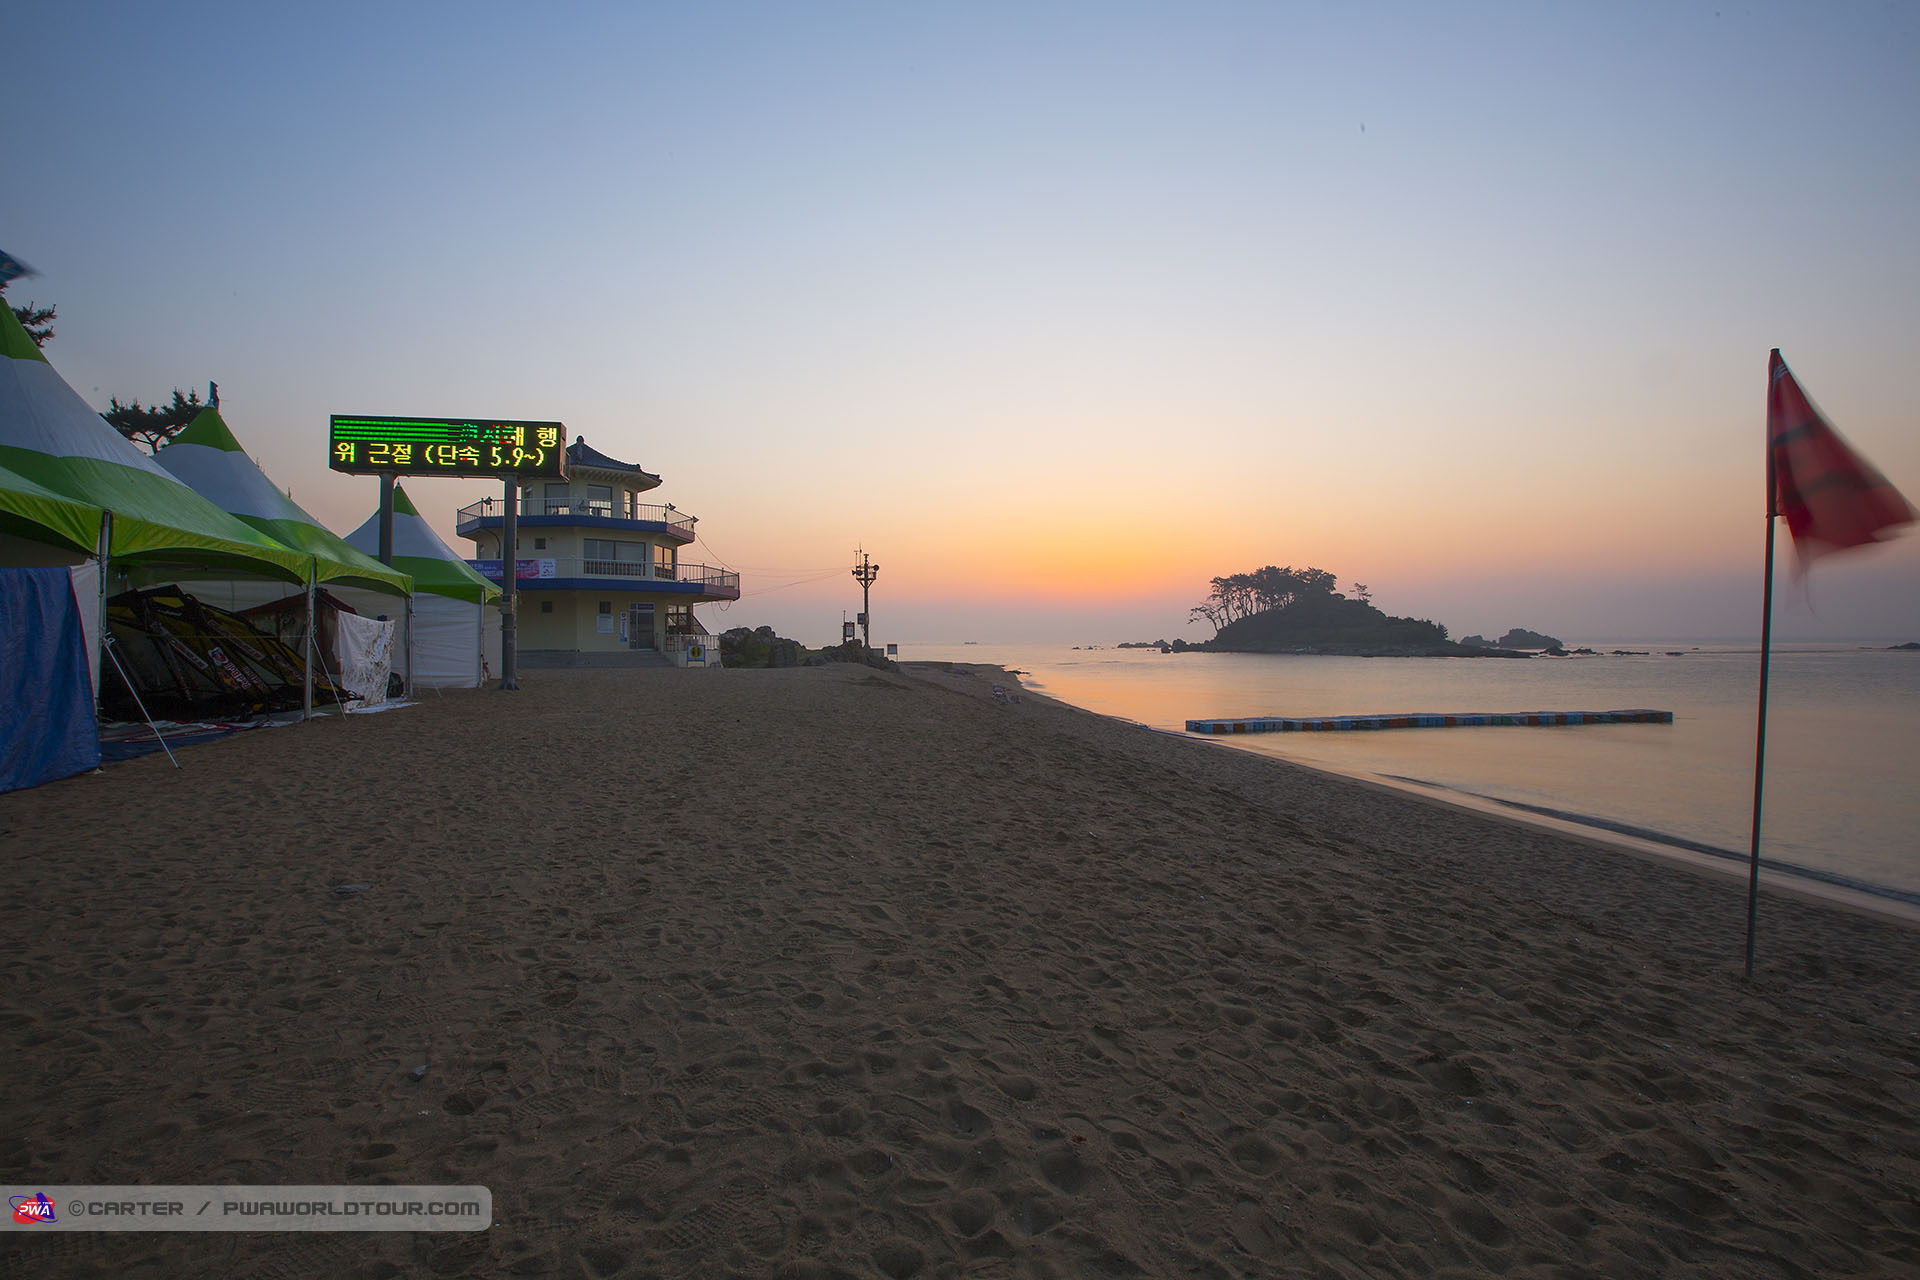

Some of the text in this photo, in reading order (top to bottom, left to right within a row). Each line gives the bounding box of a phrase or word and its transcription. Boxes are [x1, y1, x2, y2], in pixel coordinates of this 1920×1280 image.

[536, 427, 557, 447] 행
[334, 442, 545, 467] 위 근절 (단속 5.9~)
